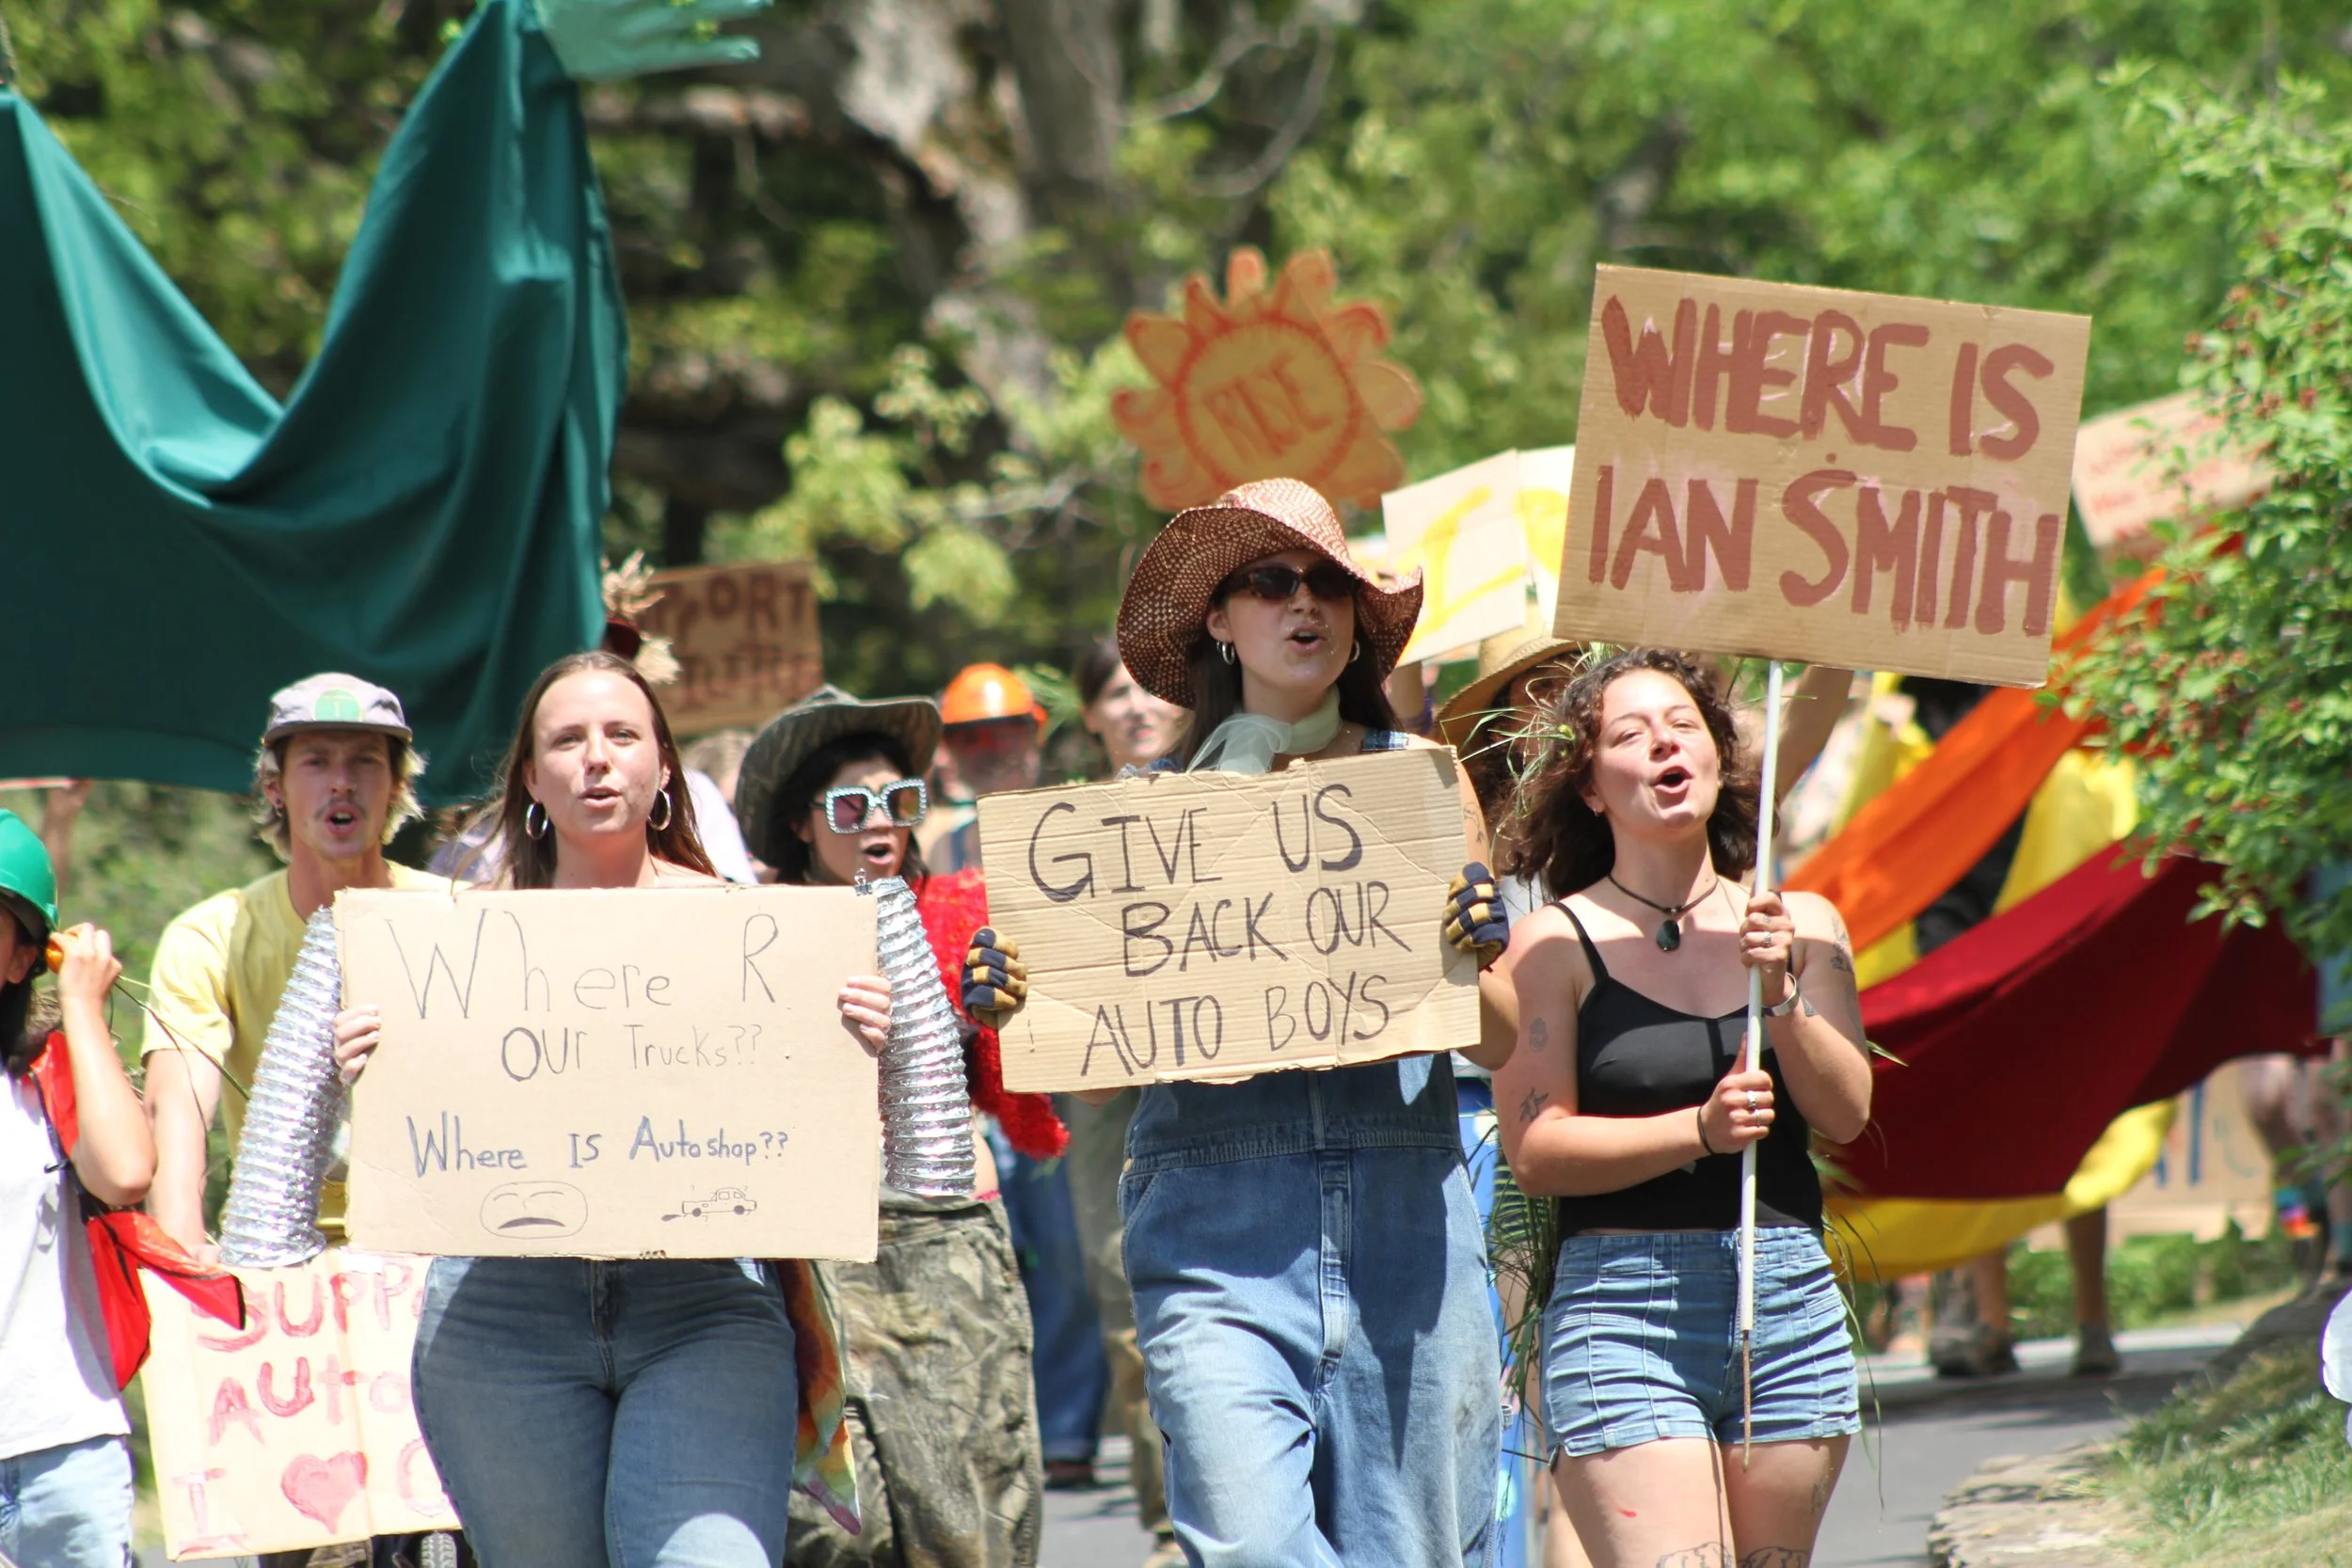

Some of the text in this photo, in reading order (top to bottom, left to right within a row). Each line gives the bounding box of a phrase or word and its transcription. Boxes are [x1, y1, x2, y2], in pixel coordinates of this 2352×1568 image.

[1601, 295, 2054, 461] WHERE IS
[1589, 465, 1758, 593] IAN
[1779, 469, 2059, 637] SMITH
[1028, 784, 1363, 903] GIVE US
[386, 909, 779, 1019] Where R
[1122, 880, 1412, 978] BACK OUR
[1081, 971, 1390, 1077] AUTO BOYS
[405, 1111, 528, 1178] Where
[191, 1260, 422, 1352] SUPP
